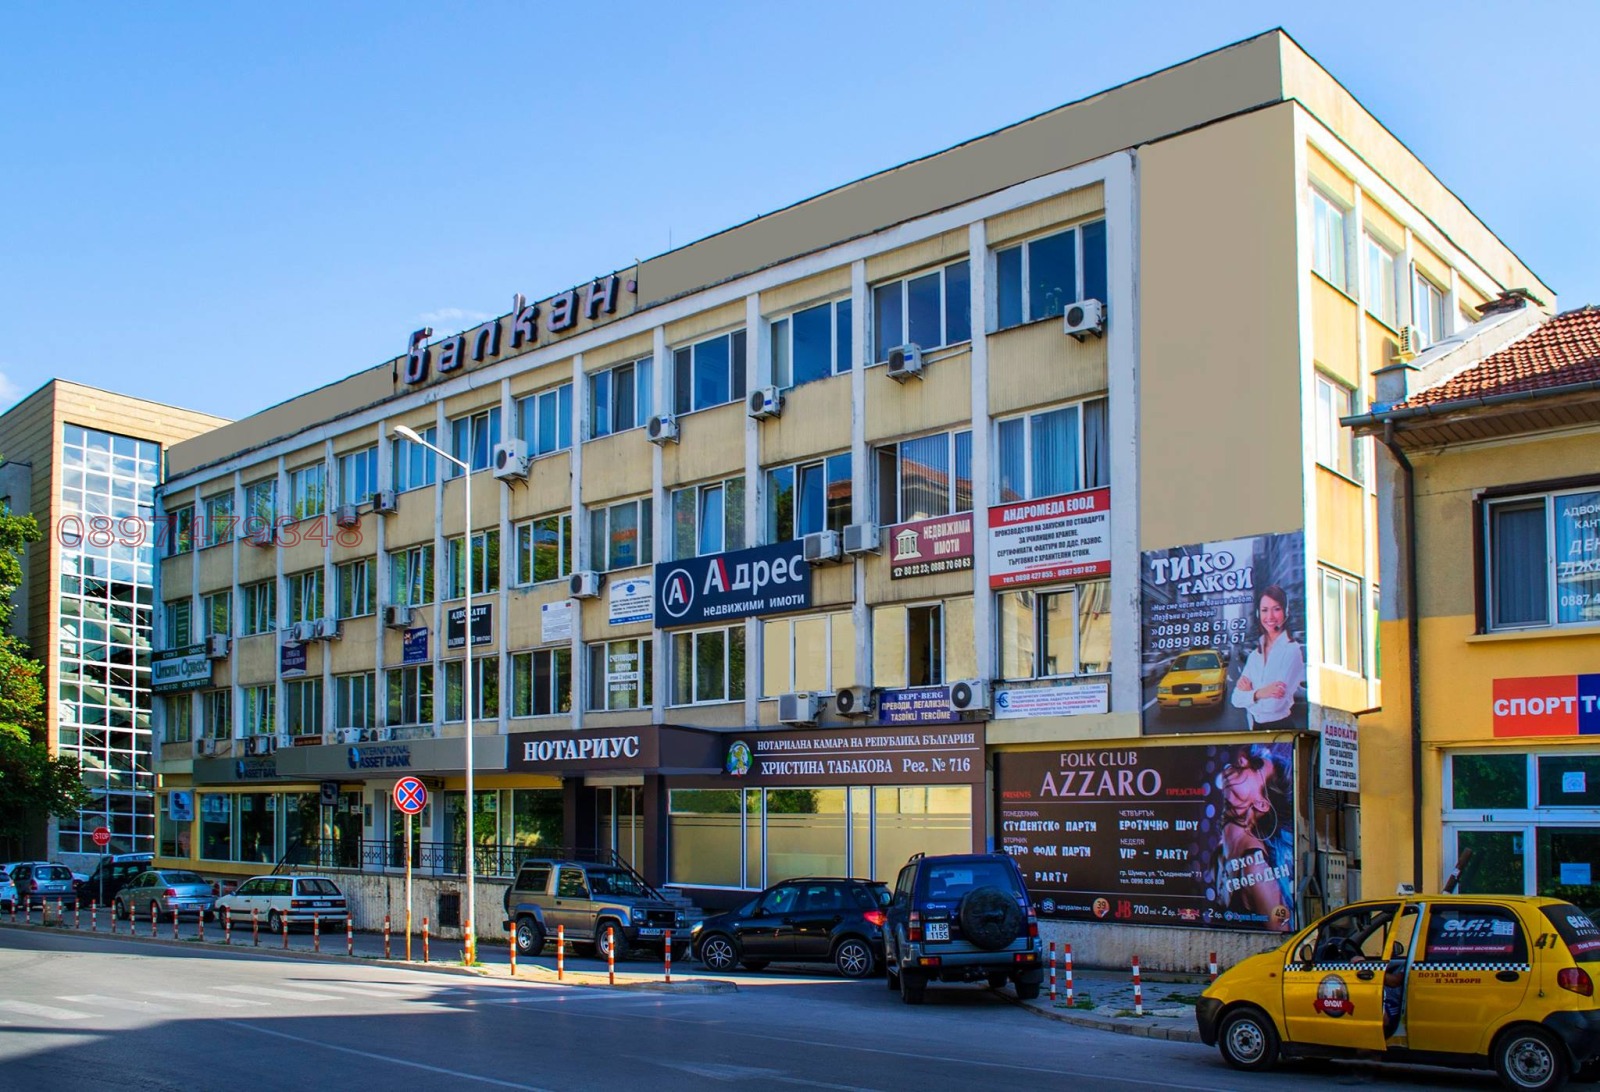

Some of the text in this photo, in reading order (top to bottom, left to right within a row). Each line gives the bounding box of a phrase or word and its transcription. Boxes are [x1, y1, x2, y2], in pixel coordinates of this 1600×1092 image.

[1003, 496, 1095, 522] АНДРОМЕДА ЕООД
[923, 519, 971, 540] НЕДВИЖИМИ
[995, 525, 1034, 537] ПРОИЗВОДСТВО
[1042, 521, 1065, 531] ЗАКУСКИ
[1066, 519, 1073, 527] ПО
[1074, 515, 1105, 526] СТАНДАРТИ
[1026, 532, 1055, 543] УЧИЛИЩНО
[934, 539, 960, 555] ИМОТИ
[1034, 543, 1058, 552] ФАКТУРИ
[1058, 541, 1066, 549] ПО
[912, 565, 920, 574] 22
[946, 560, 954, 570] 70
[963, 558, 971, 567] 63
[1008, 556, 1034, 566] ТЪРГОВИЯ
[1038, 551, 1072, 562] ХРАНИТЕЛНИ
[703, 555, 803, 596] Адрес
[1151, 551, 1234, 585] ТИКО
[1178, 567, 1253, 595] ТАКСИ
[703, 594, 805, 617] недвижими имоти
[1561, 594, 1590, 607] 0887
[1158, 619, 1247, 636] 0899 88 61 62
[1158, 633, 1246, 649] 0899 88 61 61
[1493, 696, 1577, 717] СПОРТ
[1325, 724, 1357, 741] АДВОКАТИ
[522, 736, 640, 762] НОТАРИУС
[757, 733, 975, 751] НОТАРИАЛНА КАМАРА НА РЕПУБЛИКА БЪЛГАРИЯ
[360, 744, 411, 757] INTERNATIONAL
[359, 755, 412, 769] ASSET BANK
[761, 757, 971, 775] ХРИСТИНА ТАБАКОВА Рег. № 716
[1060, 751, 1138, 767] FOLK CLUB
[1040, 768, 1162, 798] AZZARO
[1119, 809, 1155, 817] ЧЕТВЪРТЪК
[1003, 820, 1097, 832] СТУДЕНТСКО ПАРТИ
[1119, 820, 1199, 831] ЕРОТИЧНО ШОУ
[94, 832, 110, 840] STOP
[1120, 838, 1145, 846] НЕДЕЛЯ
[1003, 845, 1091, 857] РЕТРО ФОЛК ПАРТИ
[1120, 848, 1189, 860] VIP PARTY
[1230, 850, 1266, 872] ВХОД
[1035, 871, 1068, 883] PARTY
[1226, 864, 1290, 893] СВОБОДЕН
[1133, 905, 1149, 915] 700
[1162, 906, 1168, 916] 2
[1208, 908, 1214, 918] 2
[1275, 908, 1287, 918] 49
